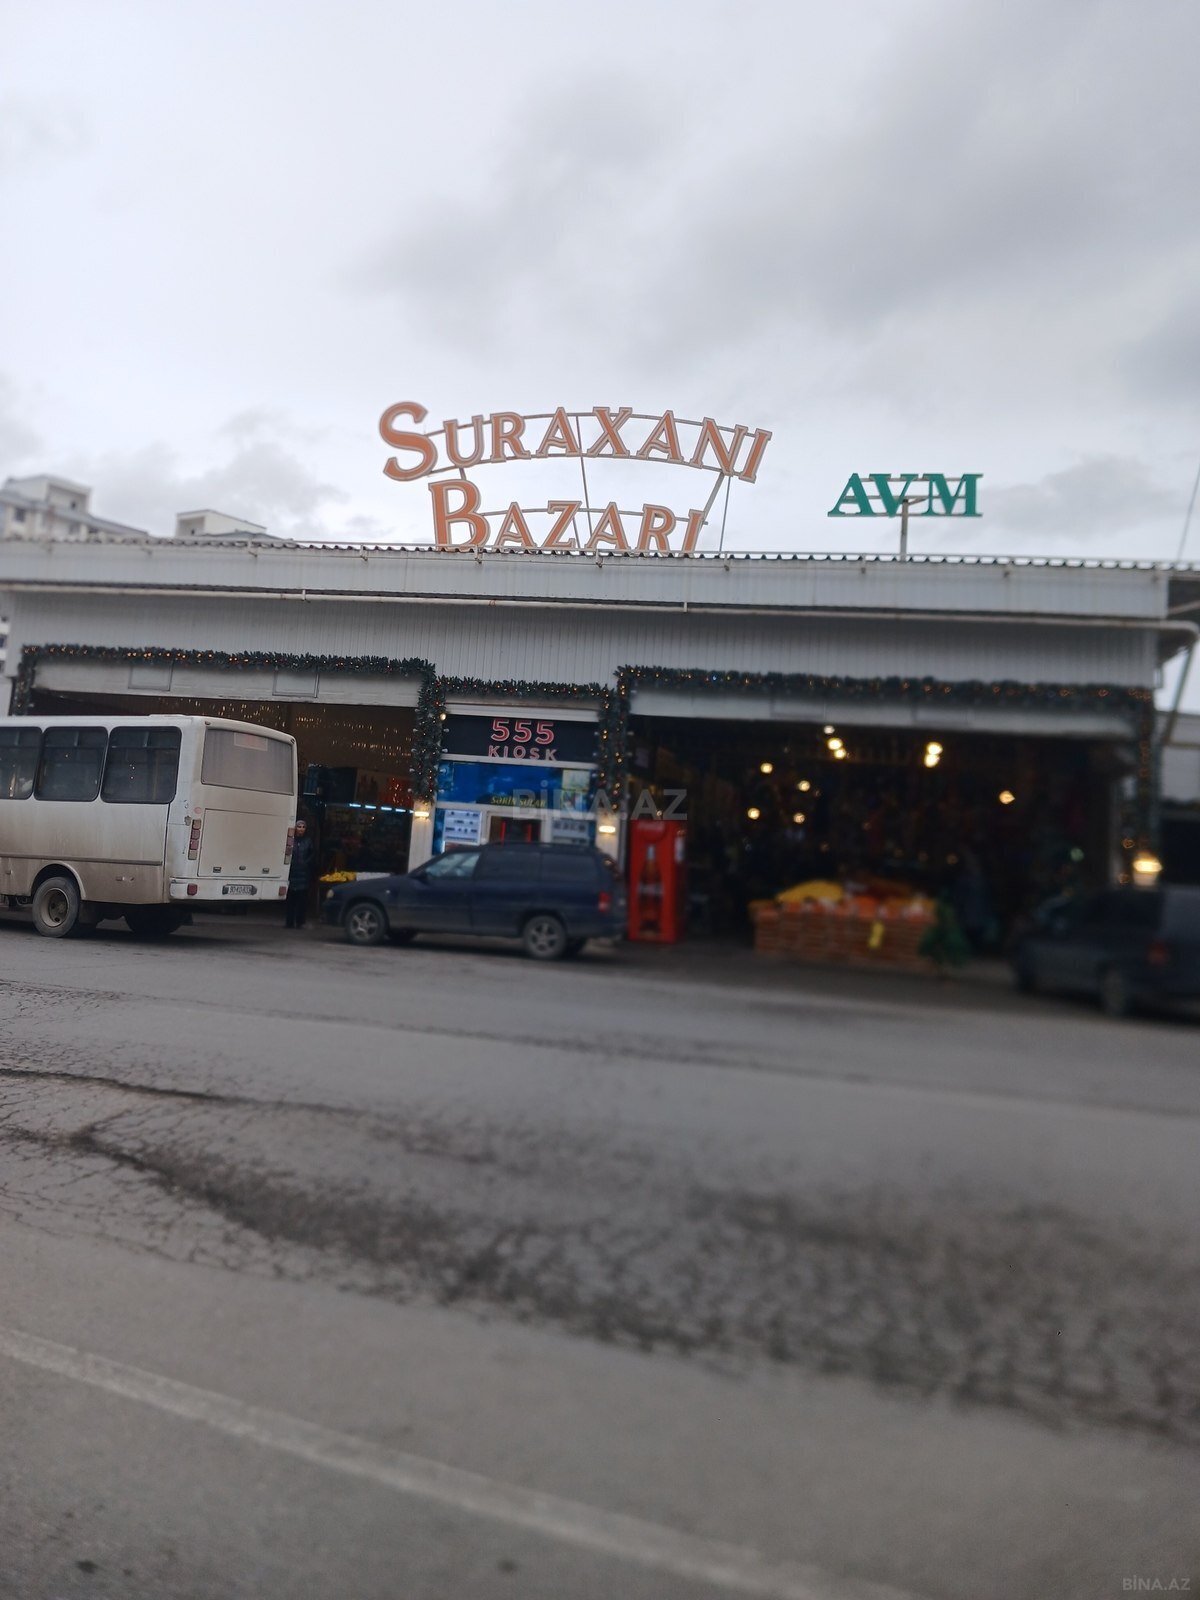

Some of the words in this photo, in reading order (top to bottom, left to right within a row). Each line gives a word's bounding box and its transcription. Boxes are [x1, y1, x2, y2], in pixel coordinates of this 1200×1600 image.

[379, 401, 773, 483] SURAXANI
[428, 479, 706, 557] BAZARI
[827, 473, 984, 518] AVM
[488, 745, 557, 761] KIOSK
[491, 718, 555, 745] 555
